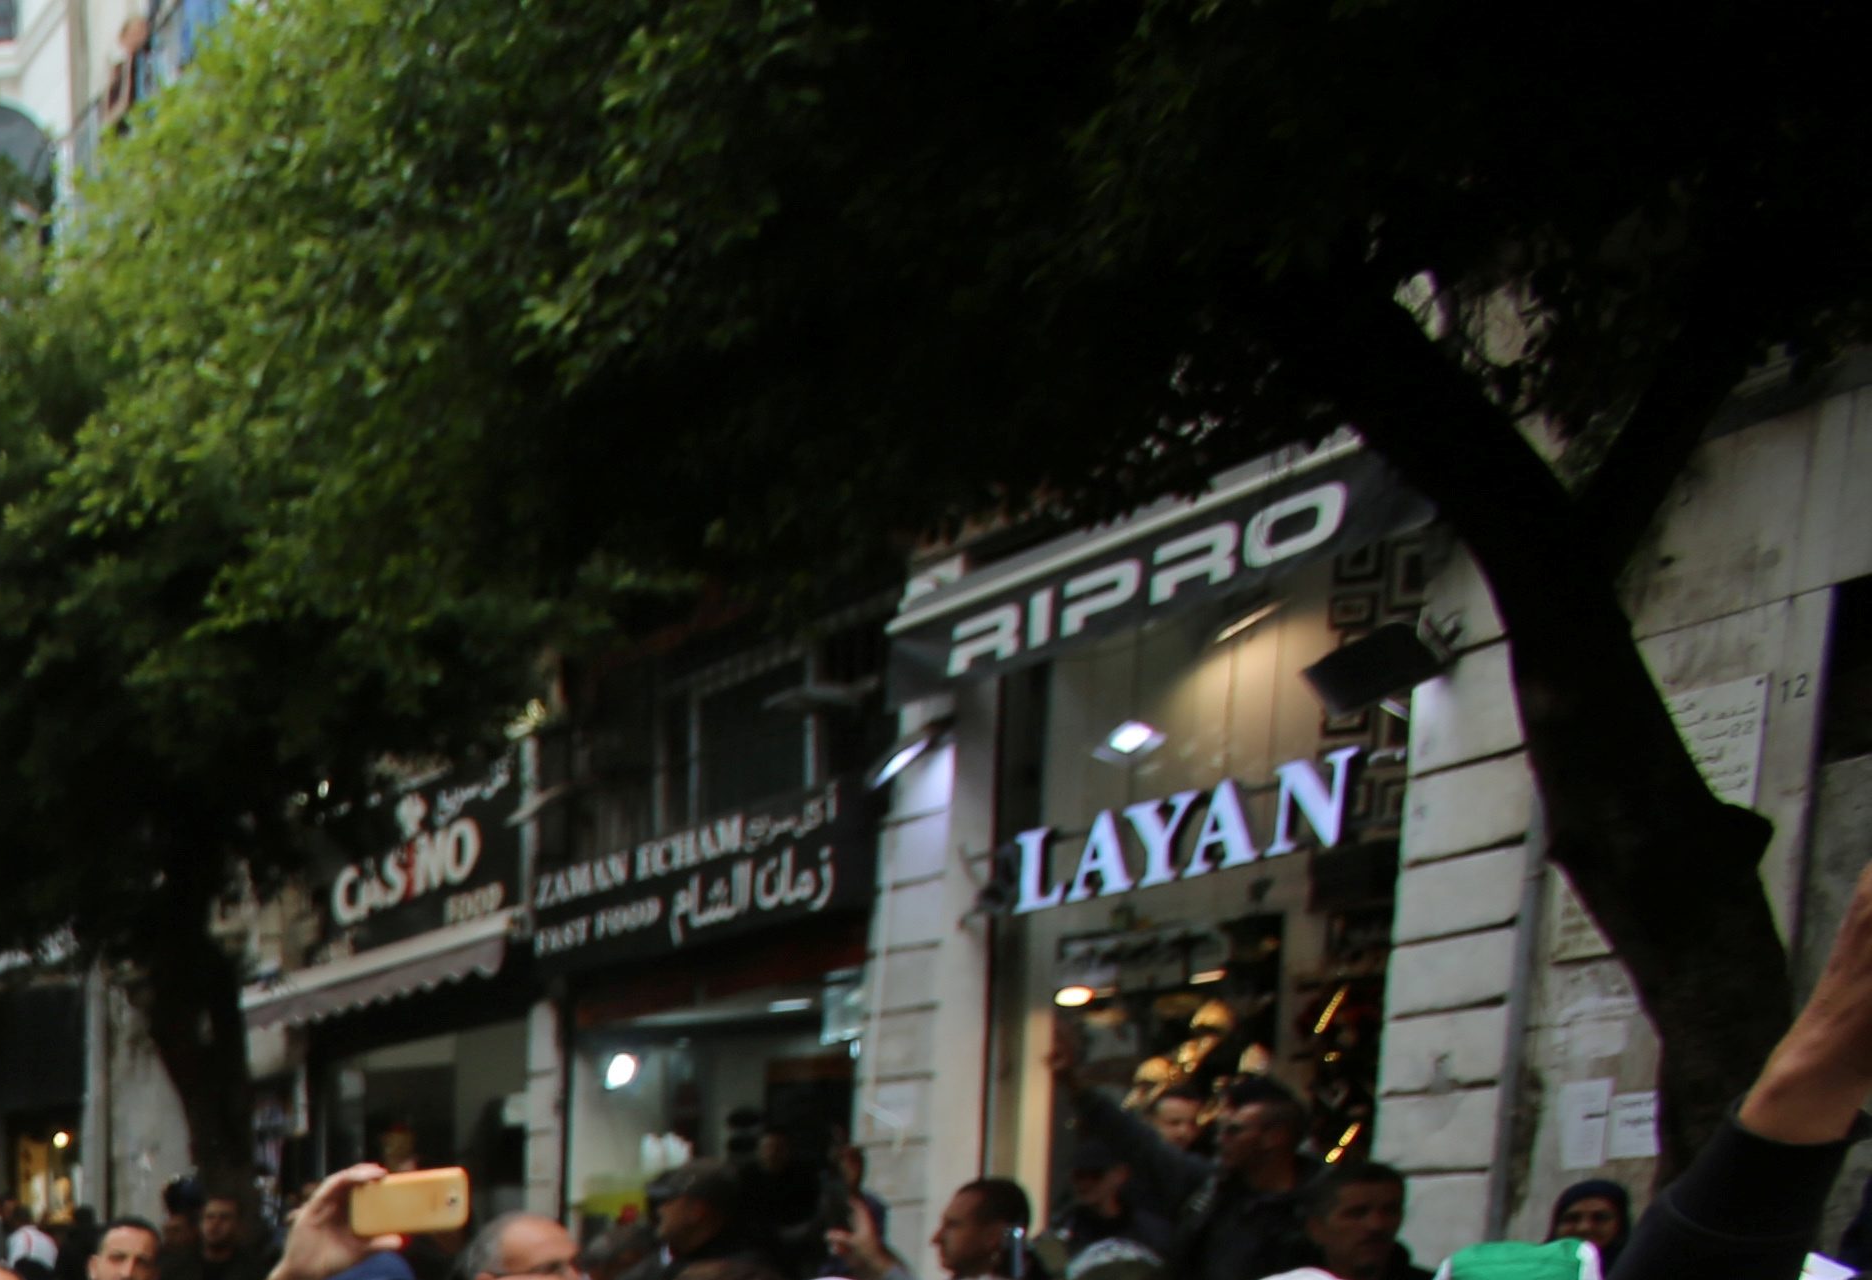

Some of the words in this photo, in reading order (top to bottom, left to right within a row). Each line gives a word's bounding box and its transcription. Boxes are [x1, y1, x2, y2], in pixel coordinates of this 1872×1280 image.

[945, 481, 1347, 679] RIPRO
[1780, 672, 1810, 704] 12
[1012, 745, 1360, 915] LAYAN
[535, 851, 631, 910] ZAMAN
[669, 859, 754, 947] الشام
[756, 845, 837, 911] زمان
[533, 915, 591, 959] FAST
[594, 897, 663, 940] FOOD
